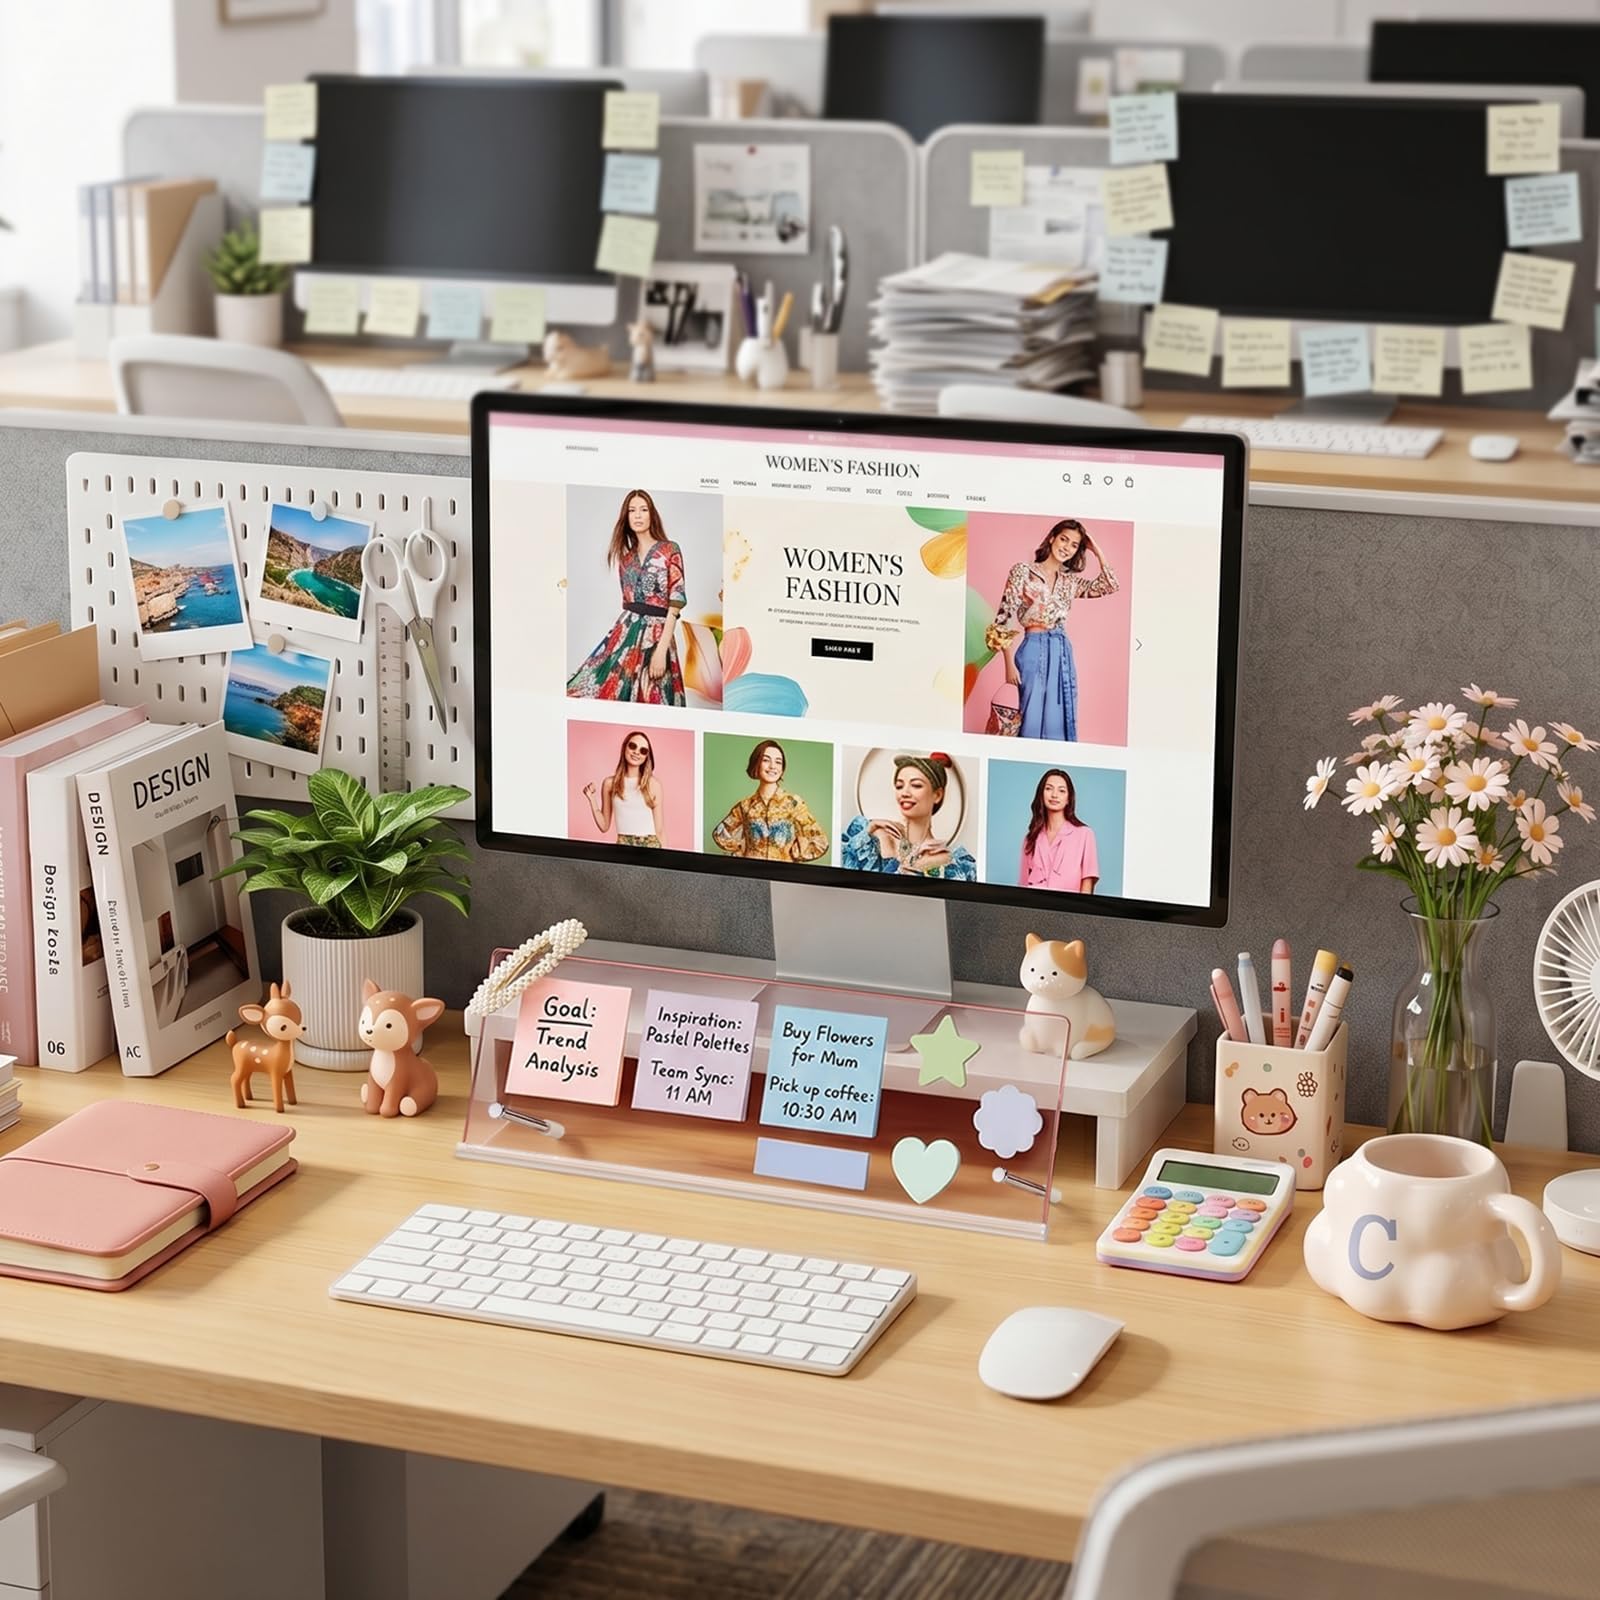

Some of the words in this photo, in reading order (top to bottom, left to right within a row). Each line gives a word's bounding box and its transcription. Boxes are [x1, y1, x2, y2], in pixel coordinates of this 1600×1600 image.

[765, 454, 844, 475] WOMEN'S
[847, 459, 921, 479] FASHION
[783, 547, 904, 577] WOMEN'S
[785, 576, 901, 607] FASHION
[133, 752, 210, 810] DESIGN
[88, 791, 109, 856] DESIGN
[543, 995, 597, 1021] Goal:
[658, 1006, 743, 1030] Inspiration:
[536, 1026, 588, 1051] Trend
[646, 1025, 690, 1047] Pastel
[693, 1031, 750, 1054] Palettes
[782, 1021, 812, 1046] Buy
[816, 1025, 875, 1047] Flowers
[47, 1040, 66, 1056] 06
[126, 1045, 142, 1058] AC
[791, 1046, 816, 1067] for
[820, 1050, 859, 1069] Mum
[525, 1052, 599, 1083] Analysis
[651, 1060, 689, 1080] Team
[694, 1066, 735, 1088] Sync:
[665, 1084, 681, 1101] 11
[685, 1086, 712, 1106] AM
[769, 1075, 799, 1093] Pick
[803, 1086, 821, 1102] up
[824, 1084, 875, 1103] coffee:
[782, 1101, 825, 1121] 10:30
[829, 1107, 858, 1125] AM
[1348, 1214, 1398, 1281] C
